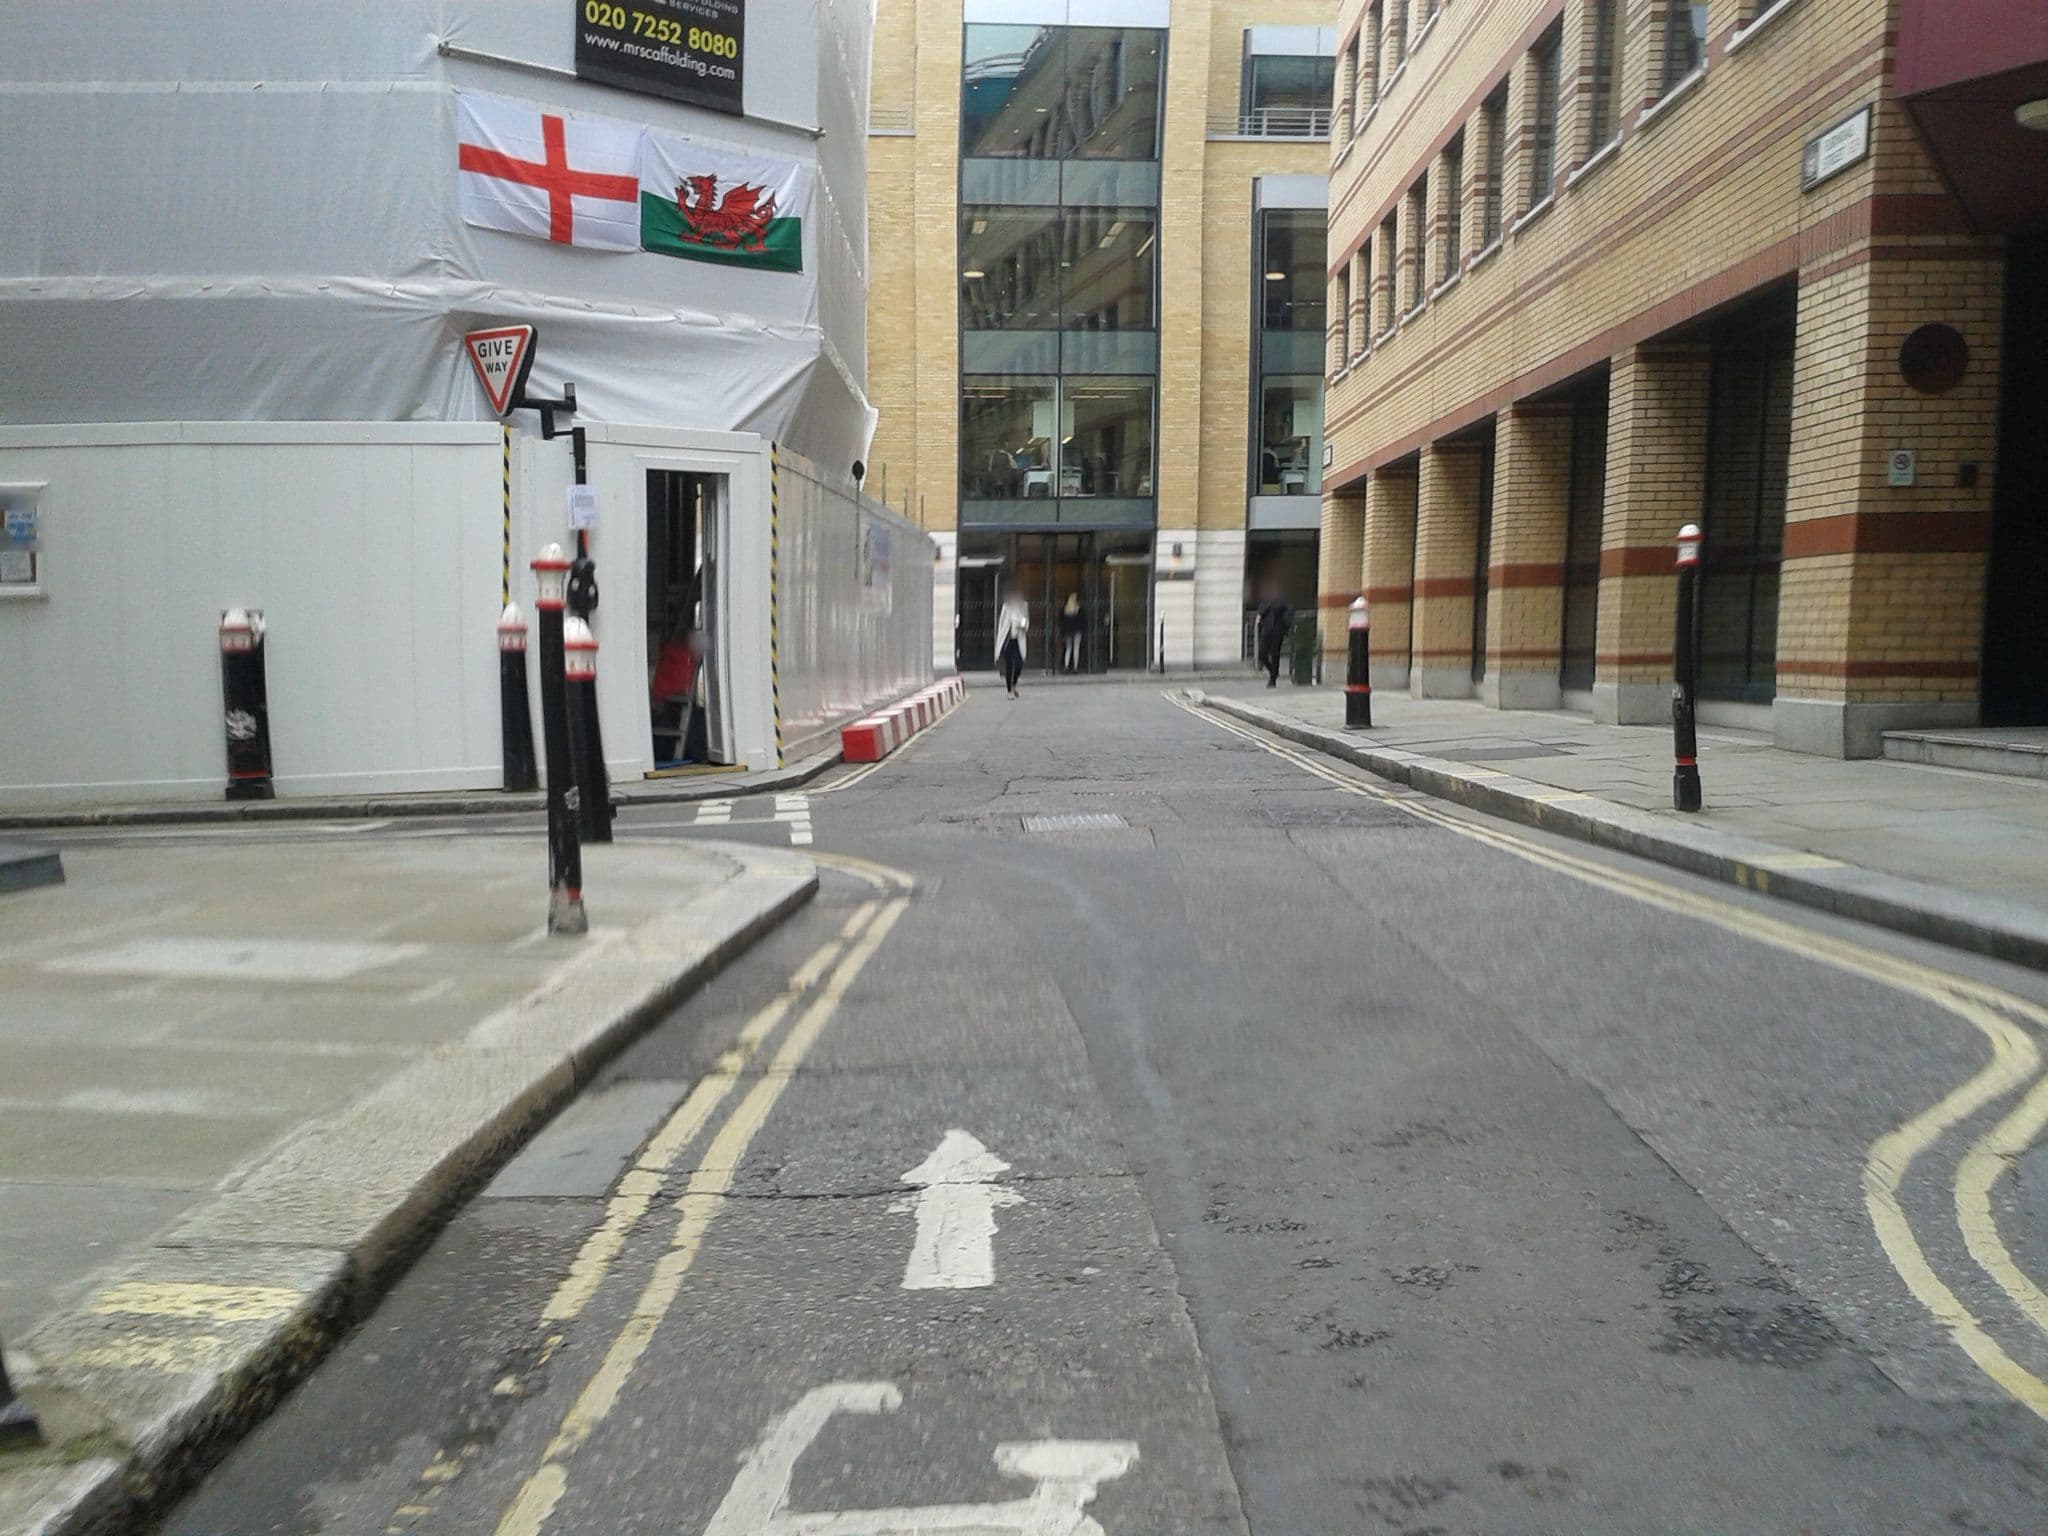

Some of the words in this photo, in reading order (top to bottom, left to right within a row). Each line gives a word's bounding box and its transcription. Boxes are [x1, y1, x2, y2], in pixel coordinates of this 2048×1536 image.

[585, 1, 626, 30] 020
[632, 11, 682, 44] 7252
[688, 27, 737, 59] 8080
[584, 33, 735, 80] www.mrscaffolding.com
[478, 340, 513, 358] GIVE
[485, 361, 507, 374] WAY
